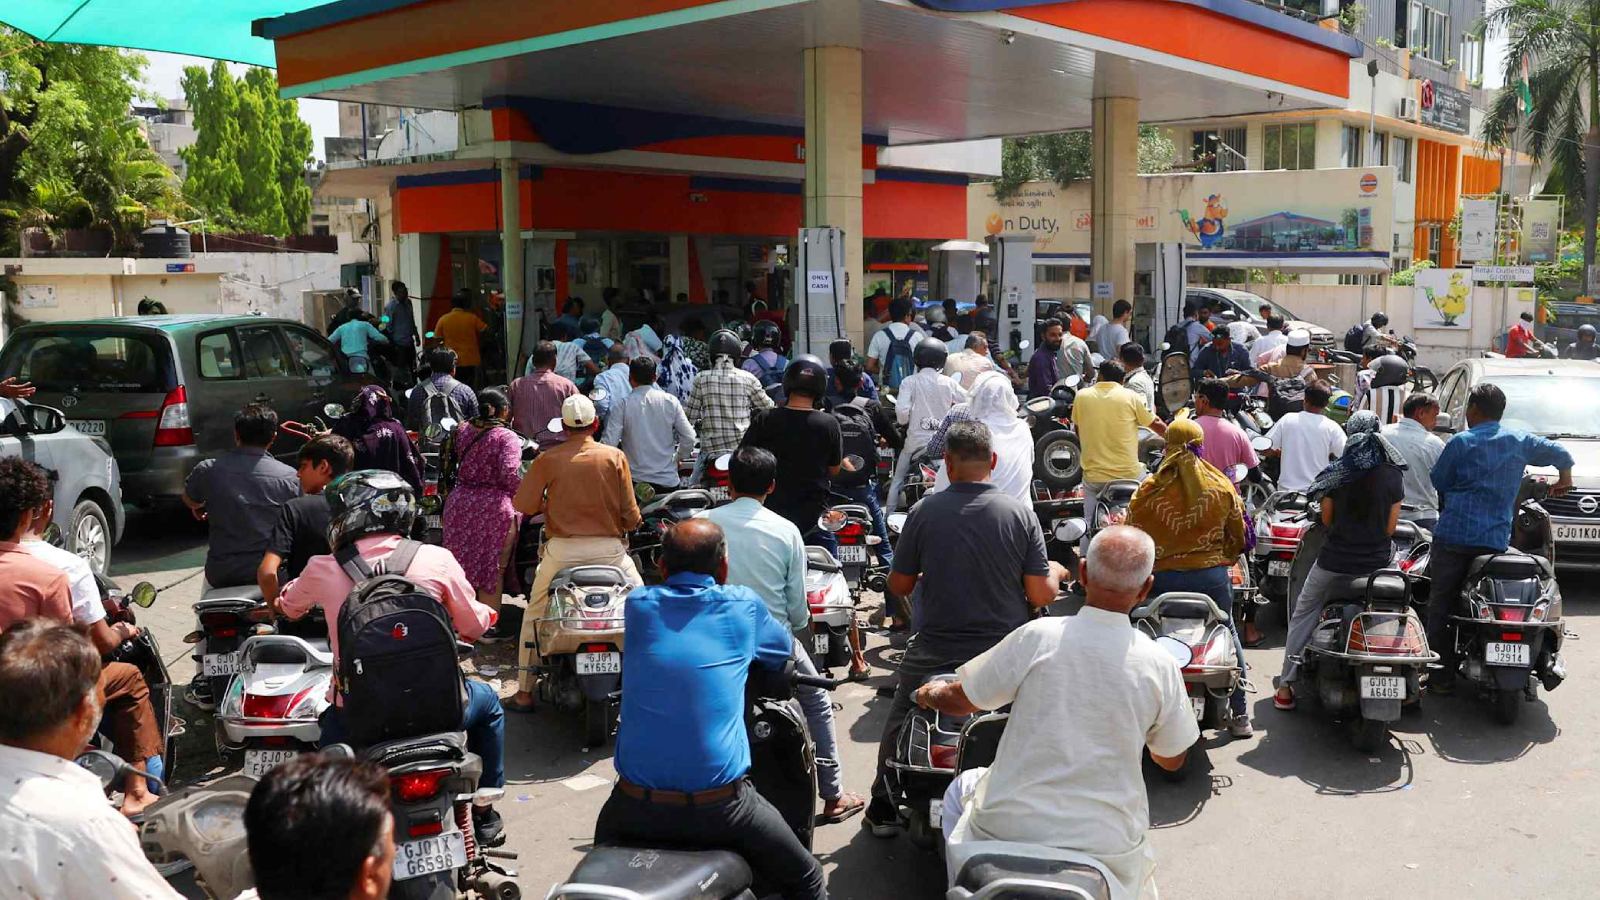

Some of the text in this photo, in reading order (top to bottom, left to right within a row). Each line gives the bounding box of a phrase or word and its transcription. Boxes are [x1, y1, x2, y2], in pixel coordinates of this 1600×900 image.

[1019, 216, 1060, 234] Duty,
[1370, 687, 1399, 698] A6405
[404, 836, 451, 860] GJ01X
[407, 853, 453, 876] G6598
